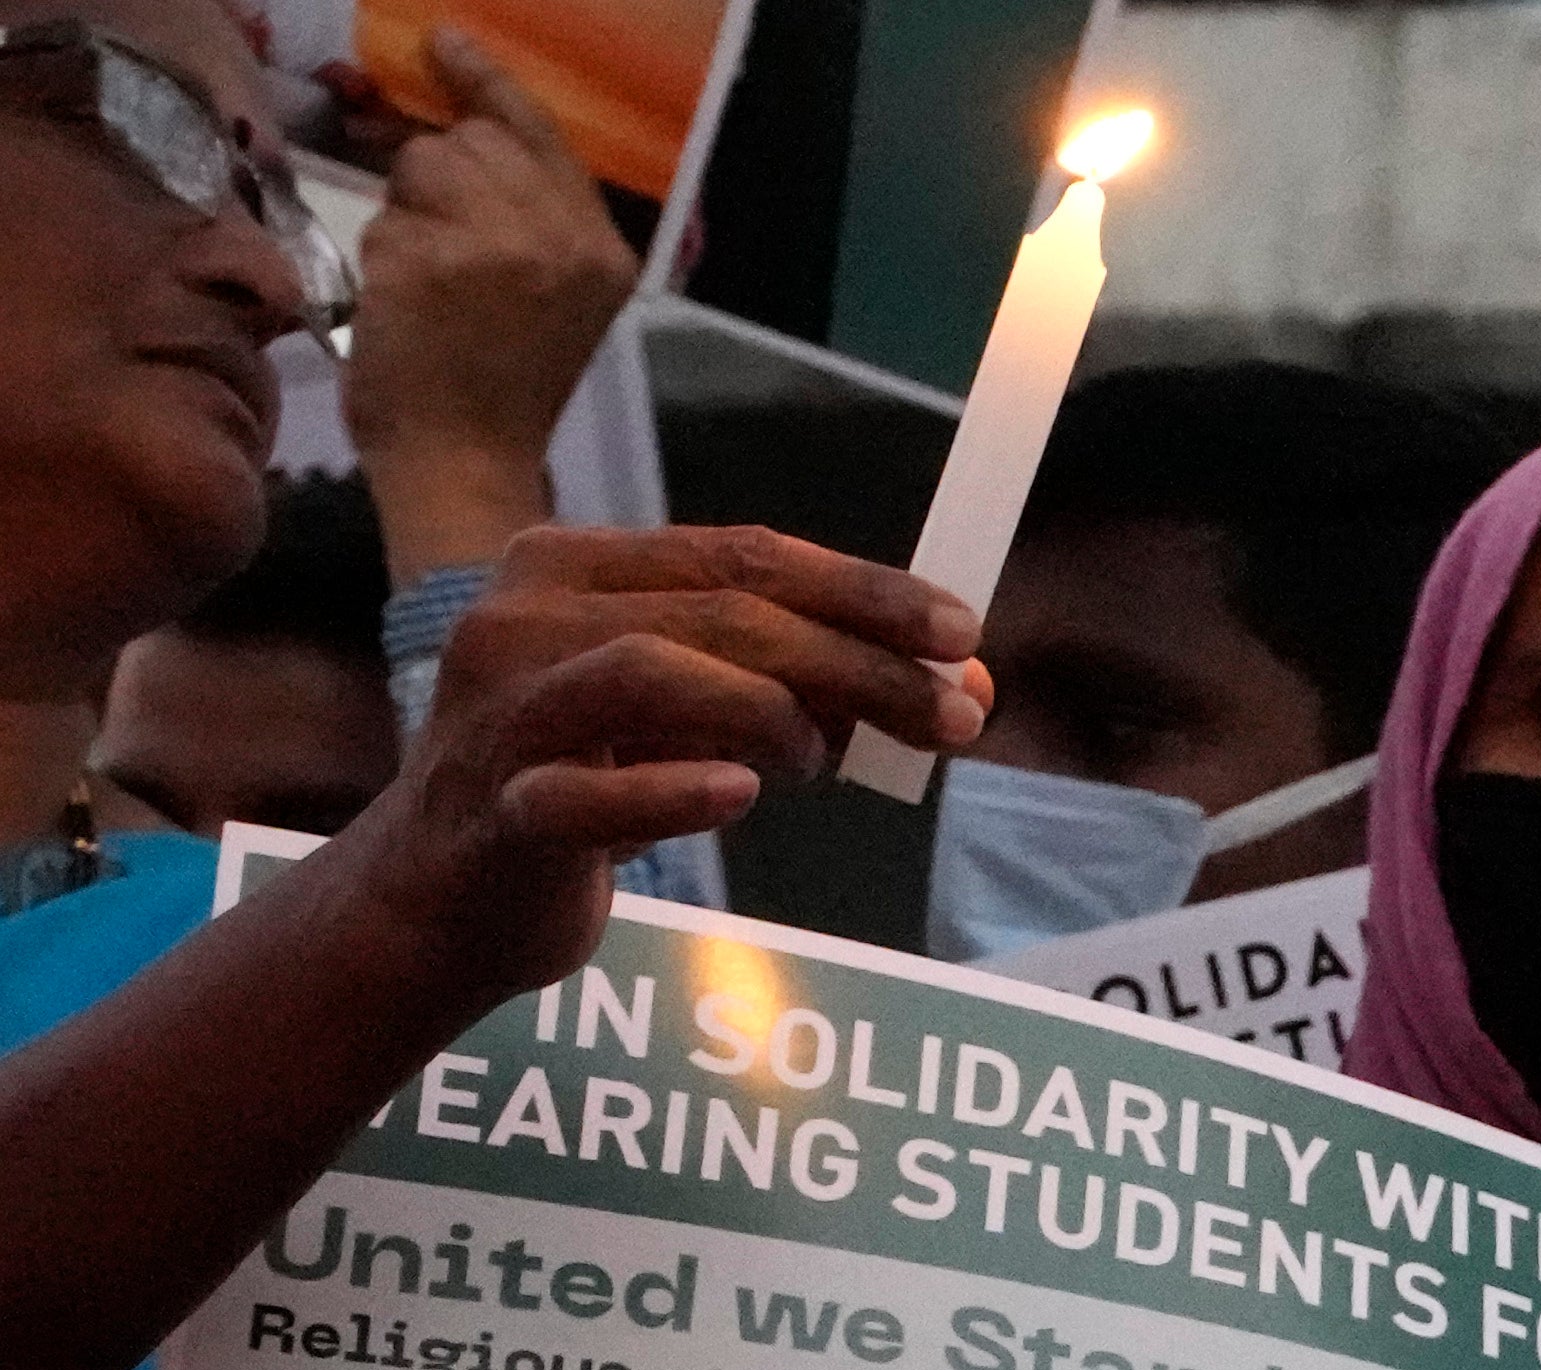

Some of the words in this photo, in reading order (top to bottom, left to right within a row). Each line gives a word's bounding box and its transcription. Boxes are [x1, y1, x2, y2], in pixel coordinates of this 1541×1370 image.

[370, 1054, 861, 1201] EARING
[890, 1140, 1450, 1340] STUDENTS
[534, 966, 656, 1059] IN
[687, 992, 1331, 1207] SOLIDARITY
[260, 1206, 700, 1333] United
[734, 1286, 905, 1364] we
